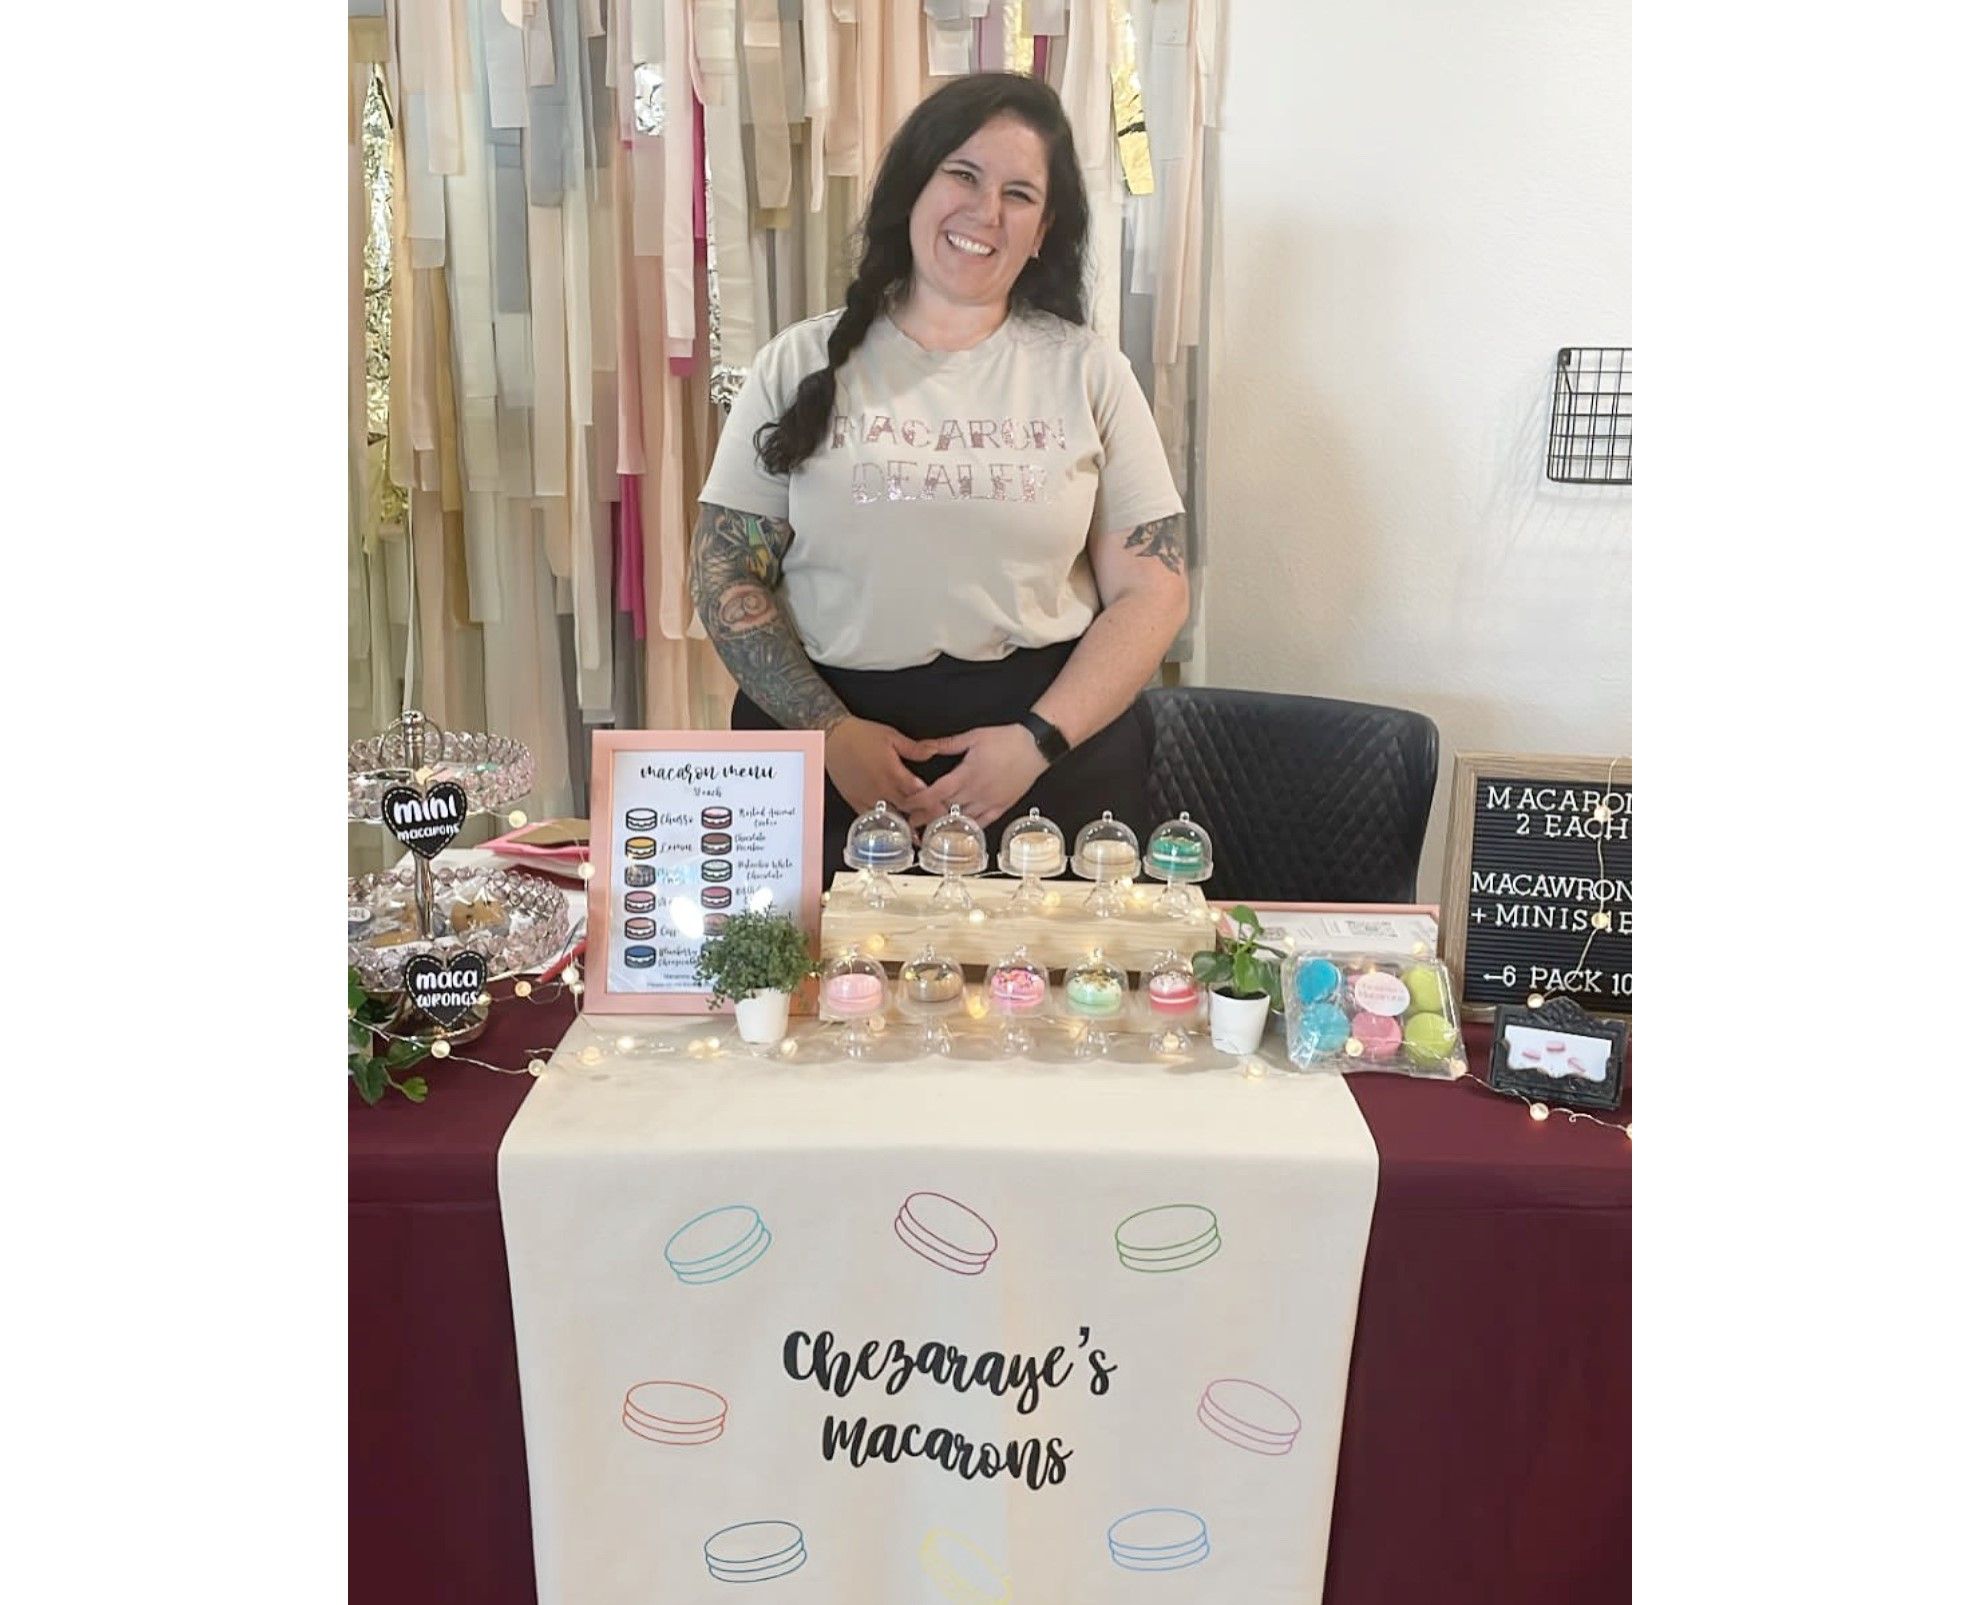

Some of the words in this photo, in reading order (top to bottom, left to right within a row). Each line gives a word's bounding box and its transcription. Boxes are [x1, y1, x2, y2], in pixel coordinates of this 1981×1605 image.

[829, 413, 1067, 451] MACARON
[851, 460, 1049, 502] DEALER
[640, 764, 717, 784] macaron
[722, 764, 775, 780] menu
[394, 794, 457, 825] mini
[398, 822, 460, 841] macarons
[1516, 813, 1530, 835] 2
[1544, 813, 1629, 841] EACH
[1471, 871, 1632, 902] MACAWRON
[1495, 903, 1588, 932] MINIS
[416, 968, 478, 991] maca
[1529, 966, 1602, 993] PACK
[1611, 973, 1632, 996] 10
[783, 1326, 1118, 1415] Chezaraye's
